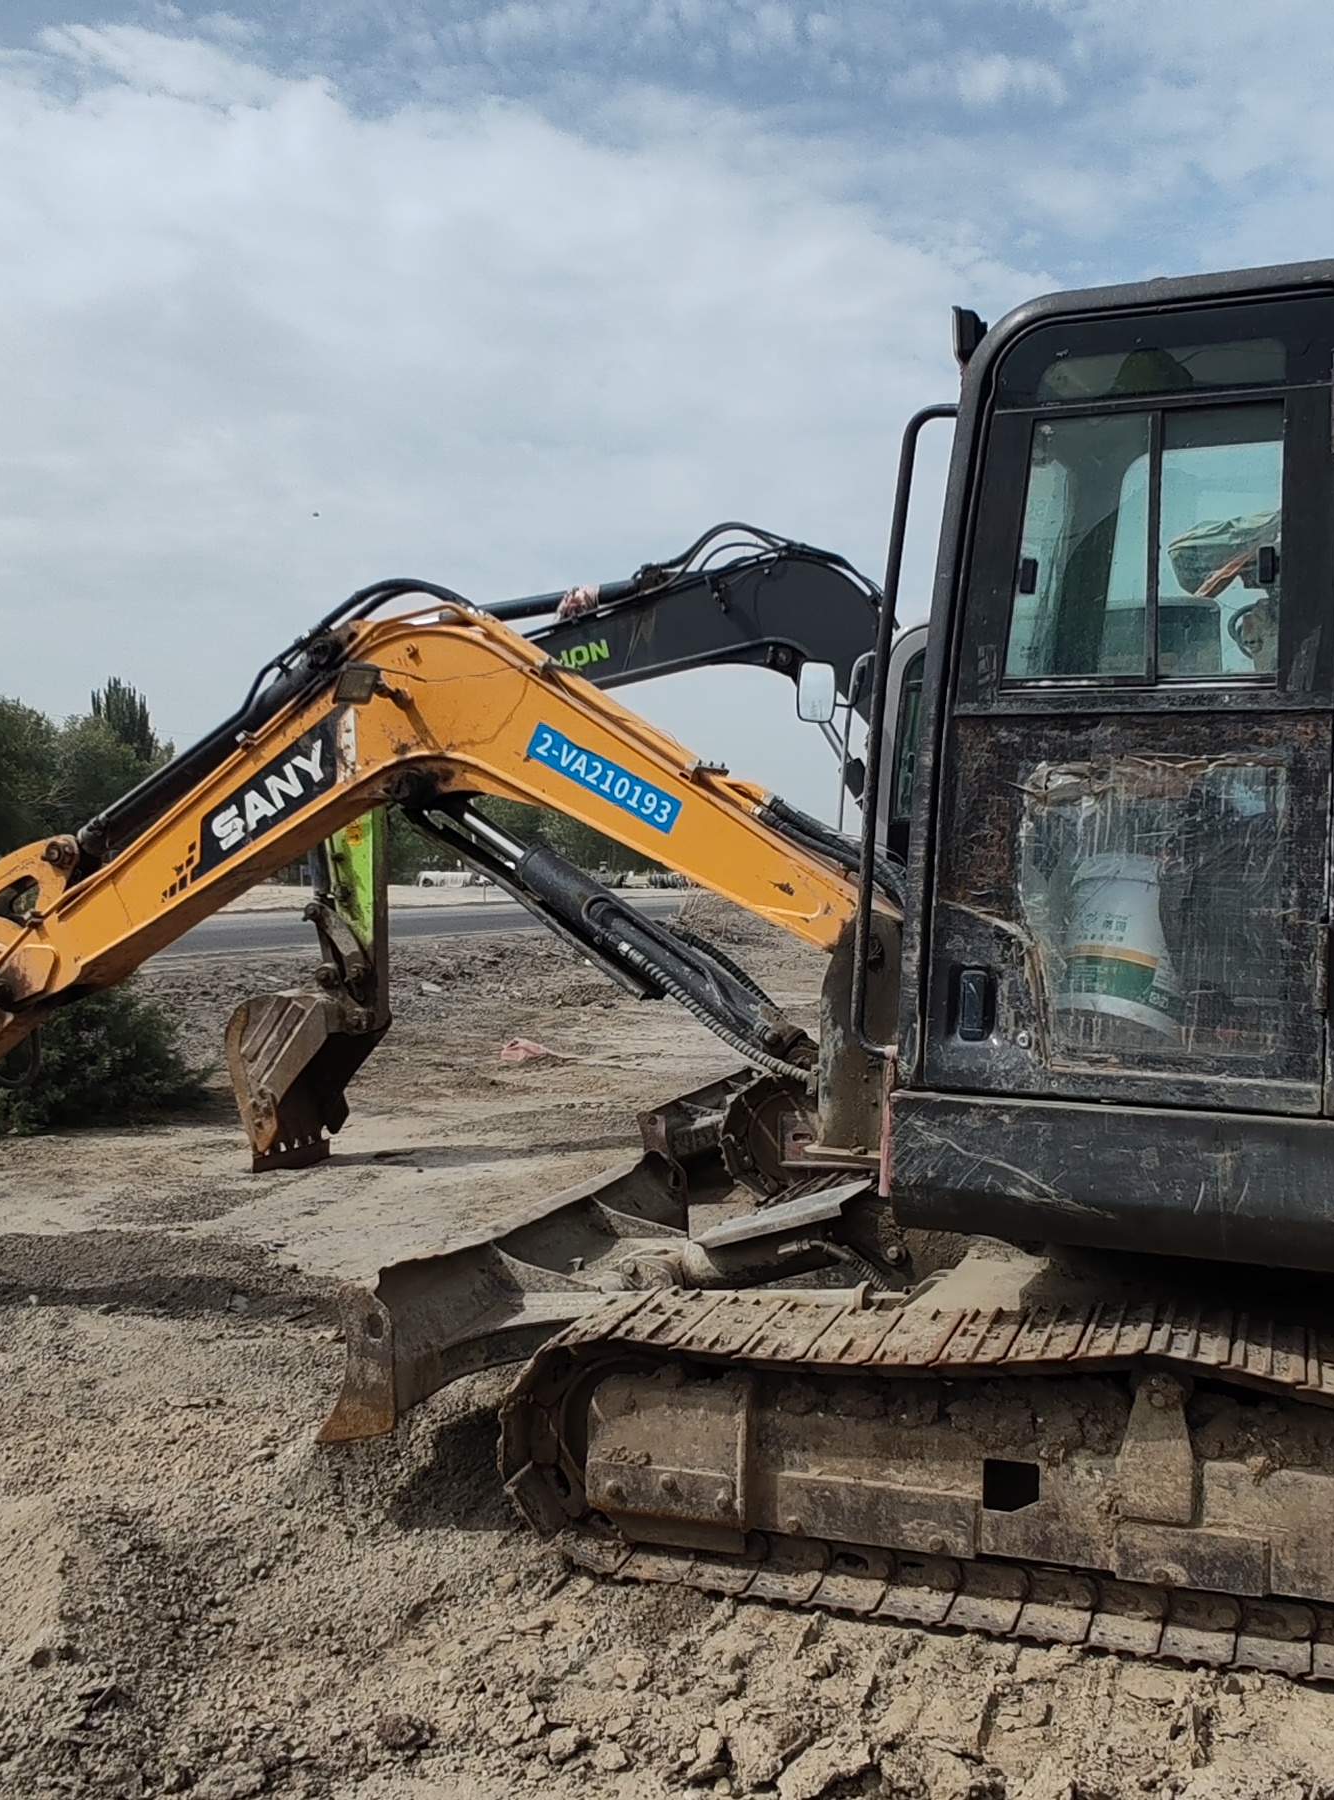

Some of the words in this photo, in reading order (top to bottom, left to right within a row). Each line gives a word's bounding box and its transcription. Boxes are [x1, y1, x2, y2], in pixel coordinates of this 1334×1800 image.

[560, 638, 610, 669] ION
[211, 739, 324, 851] SANY
[535, 732, 672, 824] 2-VA210193
